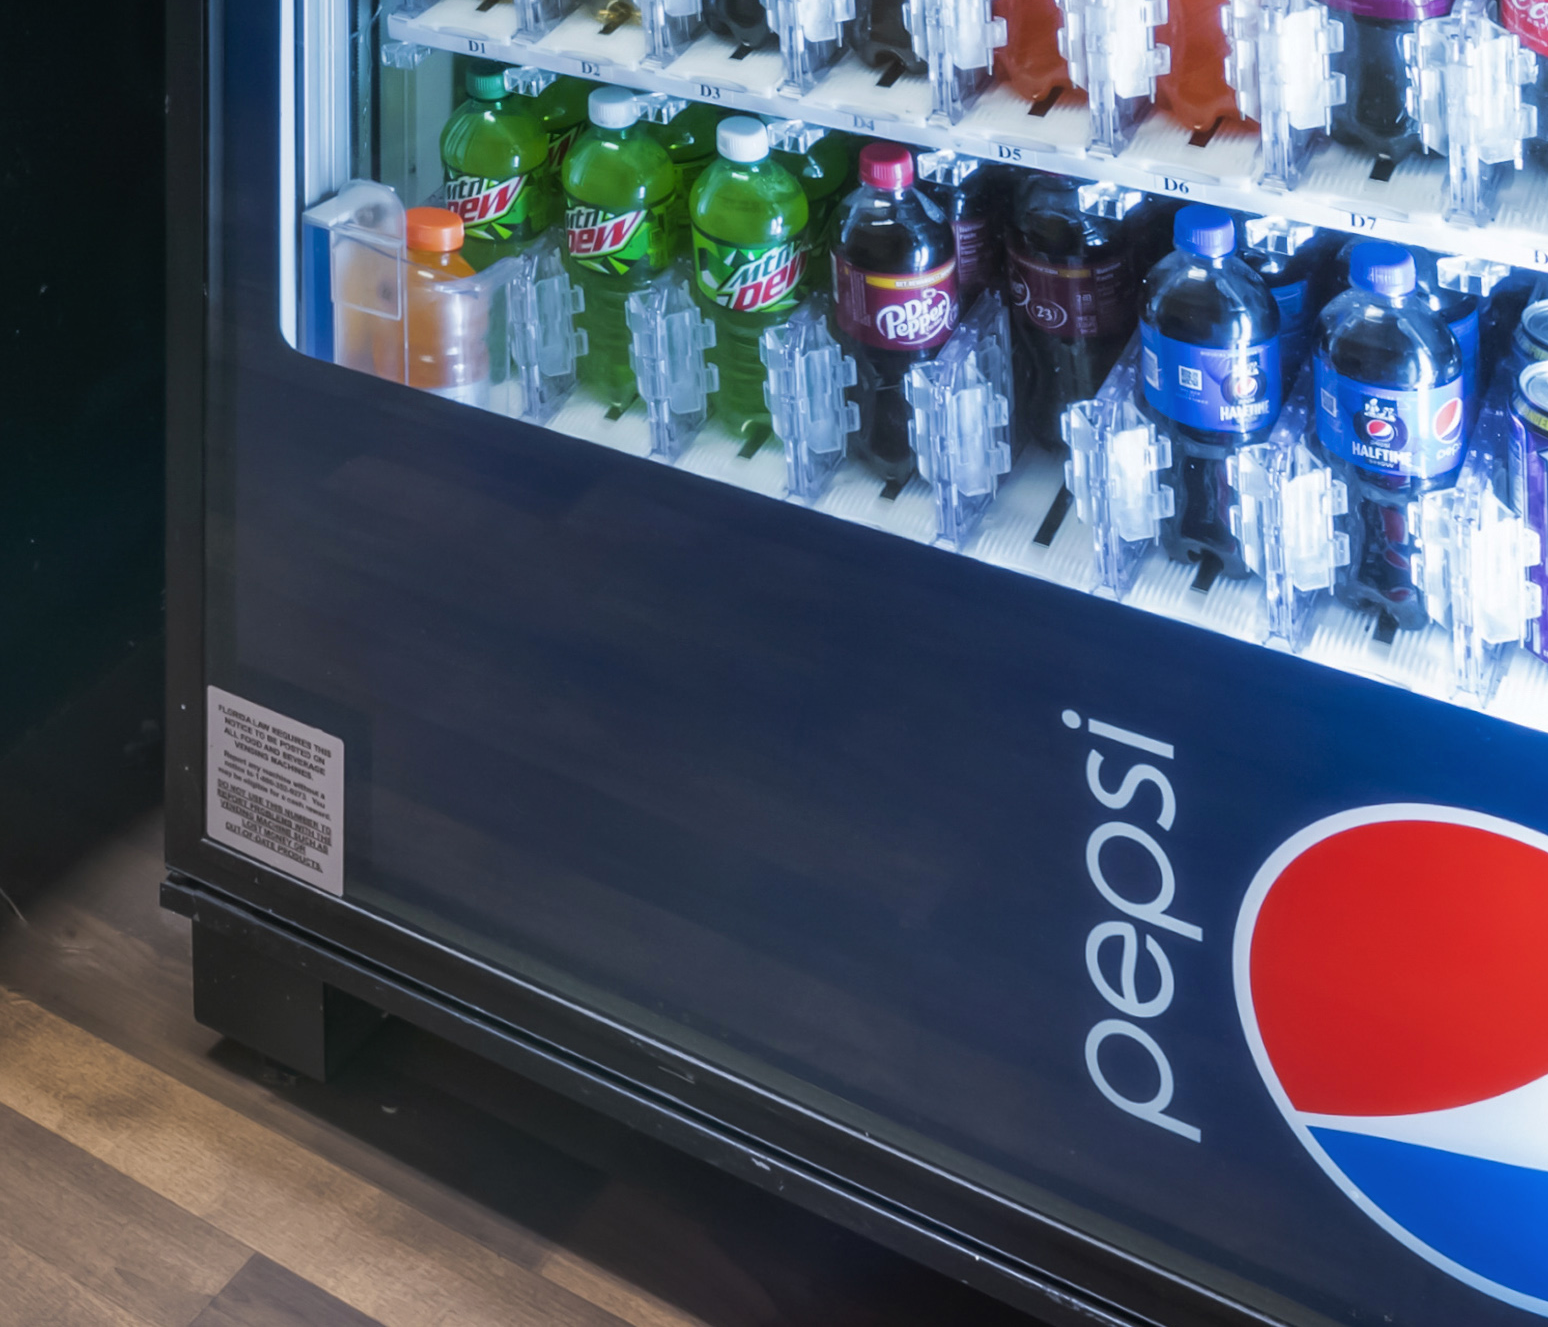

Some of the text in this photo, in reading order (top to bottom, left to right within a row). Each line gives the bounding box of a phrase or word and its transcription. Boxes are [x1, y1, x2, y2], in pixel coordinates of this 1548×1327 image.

[1163, 176, 1190, 195] D6
[904, 298, 932, 317] Dr
[1036, 305, 1052, 321] 23
[884, 300, 946, 341] Pepper
[1352, 441, 1412, 467] HALFTIME
[1062, 709, 1203, 1143] pepsi
